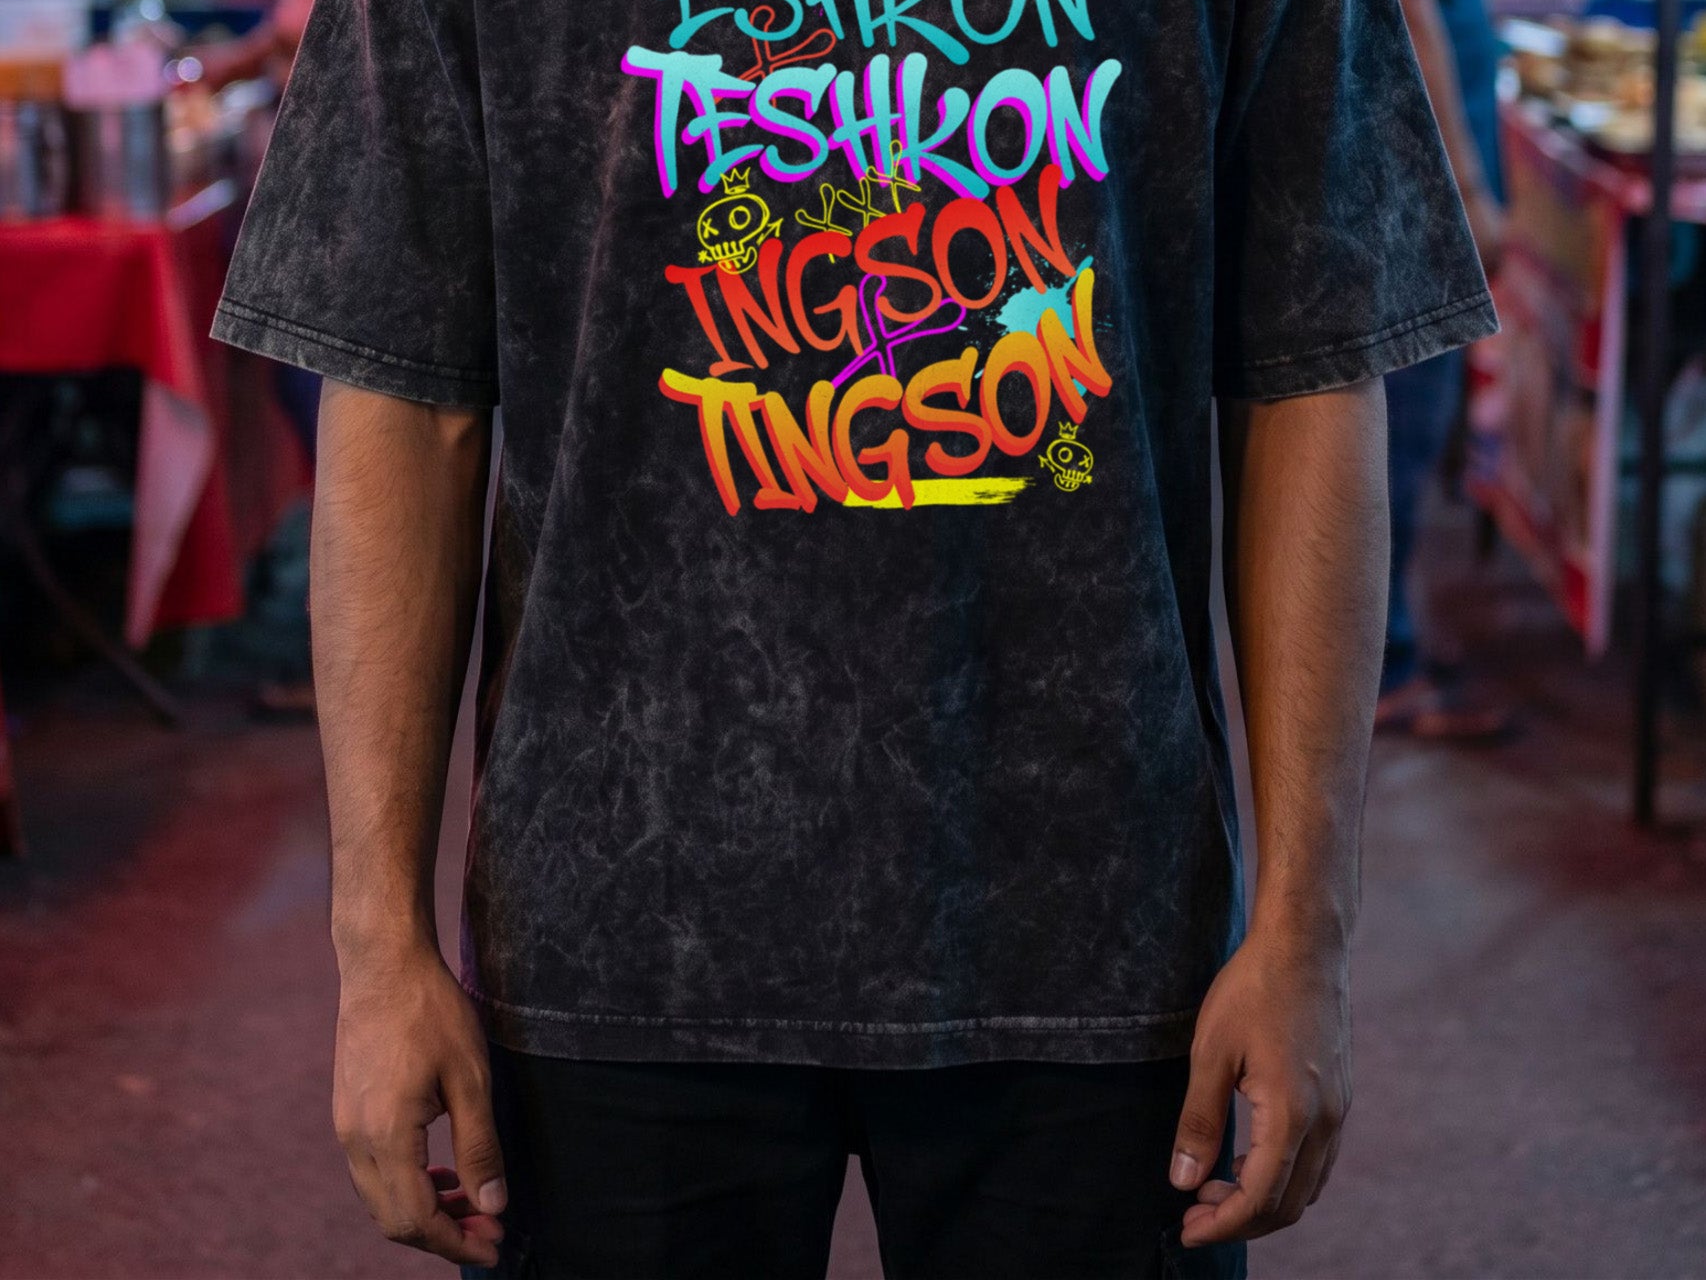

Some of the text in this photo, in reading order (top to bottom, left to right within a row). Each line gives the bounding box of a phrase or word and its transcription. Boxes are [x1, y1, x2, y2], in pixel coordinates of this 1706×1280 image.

[621, 45, 1121, 199] TESHKON
[665, 164, 1077, 376] INGSON
[658, 267, 1112, 516] TINGSON
